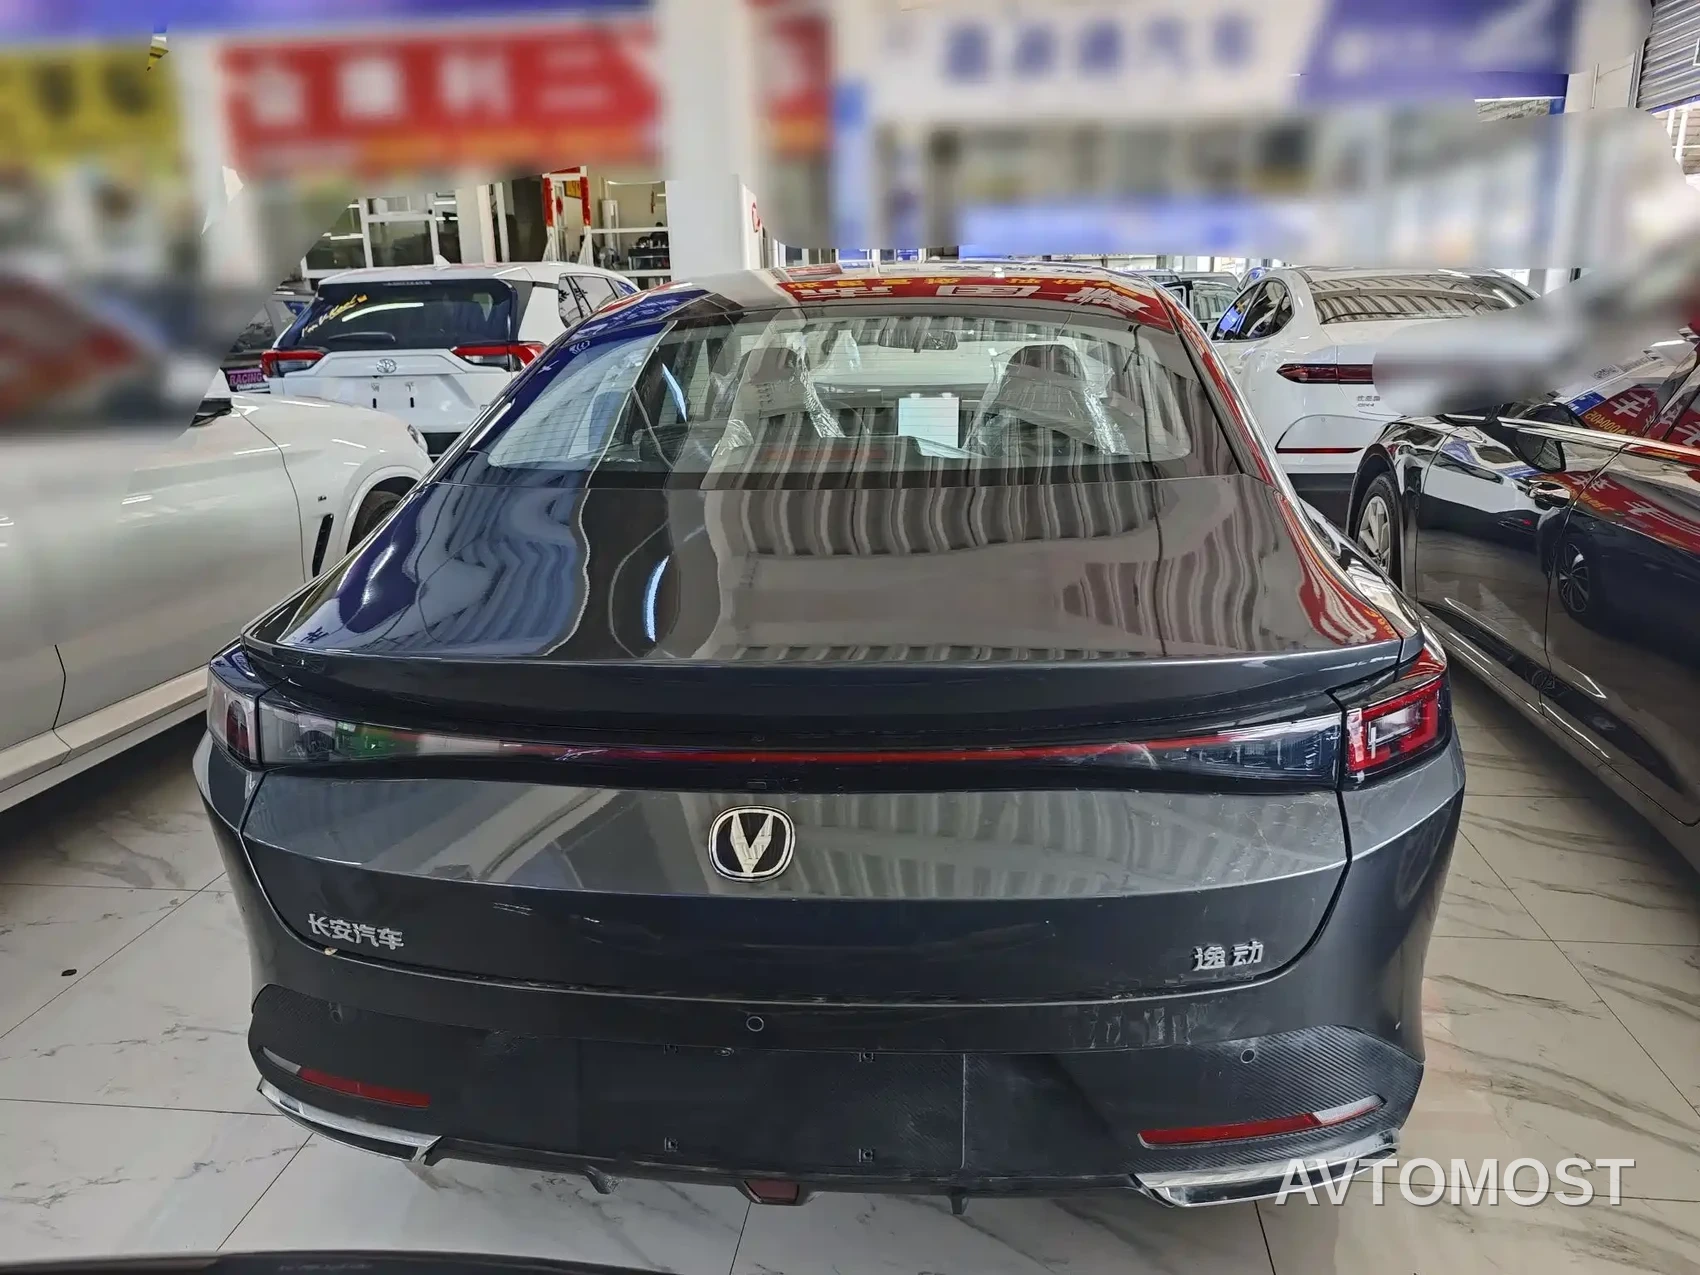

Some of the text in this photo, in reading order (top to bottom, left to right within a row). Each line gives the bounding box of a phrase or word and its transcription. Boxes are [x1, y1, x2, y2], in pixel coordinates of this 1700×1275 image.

[229, 372, 263, 387] RACING
[308, 913, 404, 950] 长安汽车
[1192, 940, 1264, 971] 逸动
